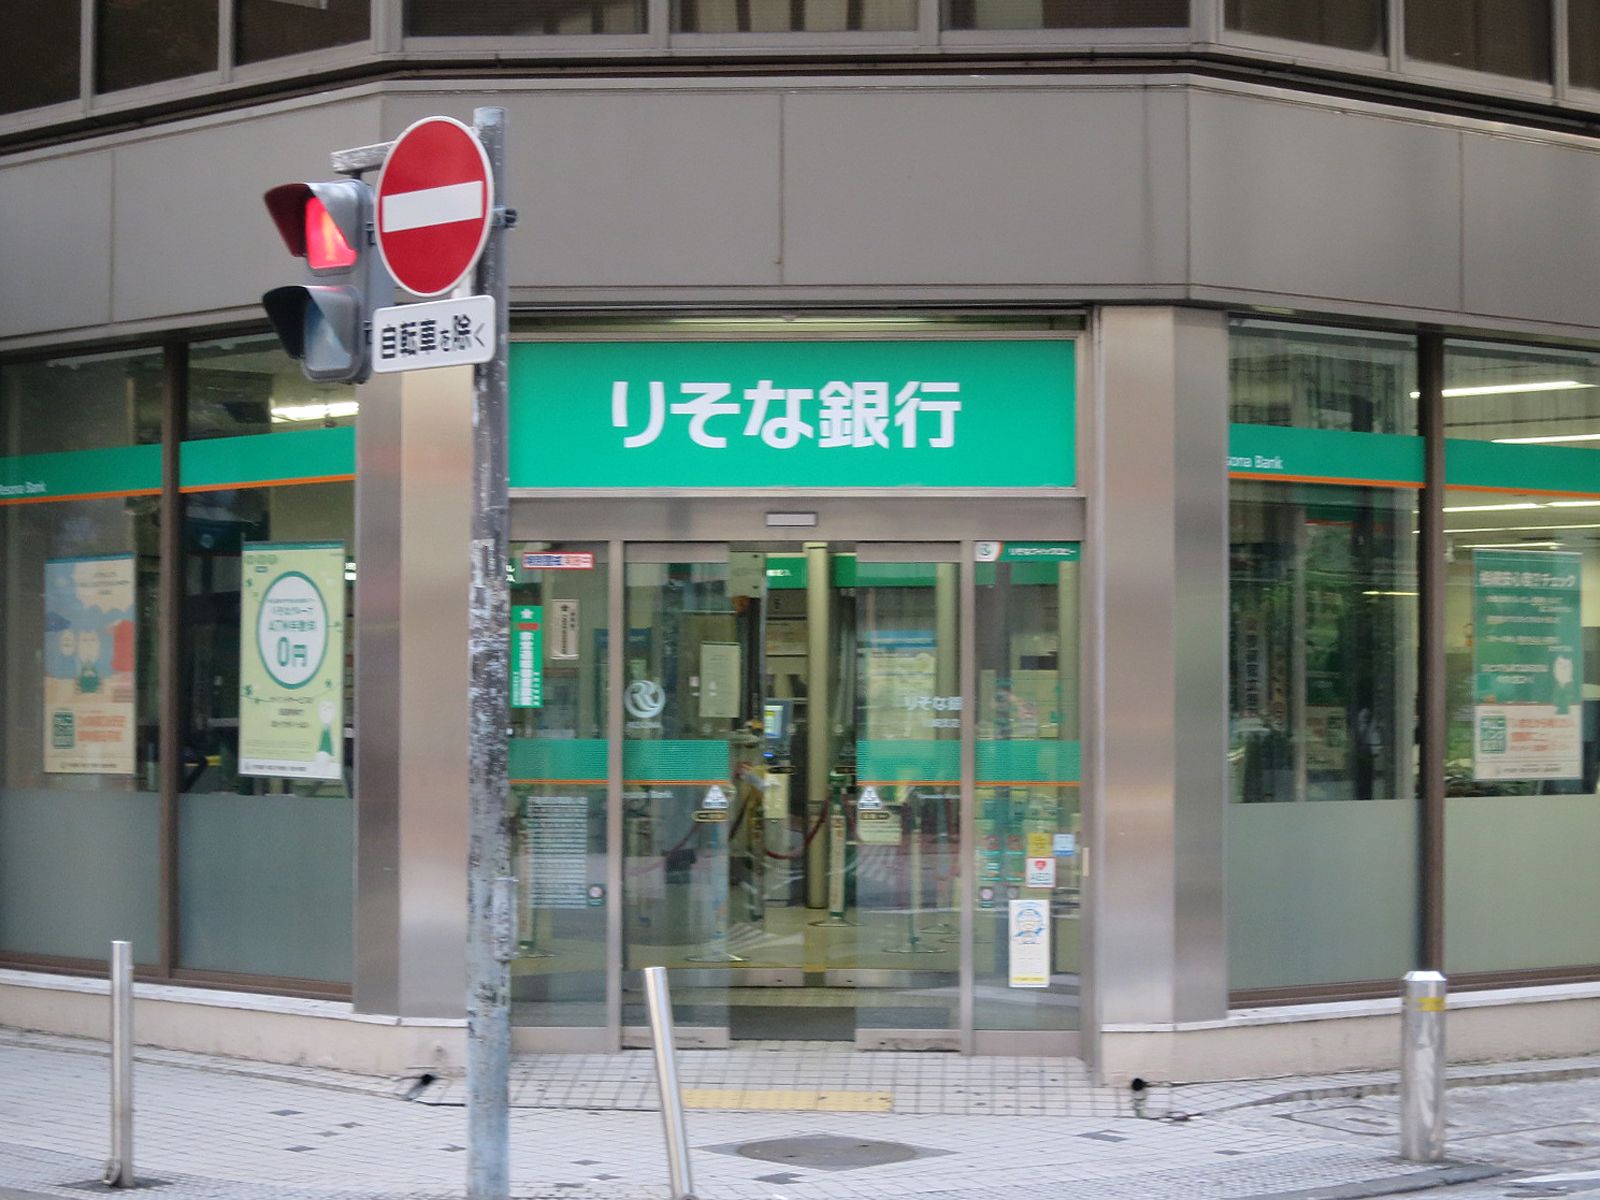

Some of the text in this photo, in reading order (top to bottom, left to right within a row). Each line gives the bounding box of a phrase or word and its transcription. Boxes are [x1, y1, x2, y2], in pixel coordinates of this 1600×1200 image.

[381, 313, 486, 360] 自転車を除く
[611, 380, 962, 449] りそな銀行
[1254, 455, 1284, 469] Bank
[277, 636, 307, 668] 0円
